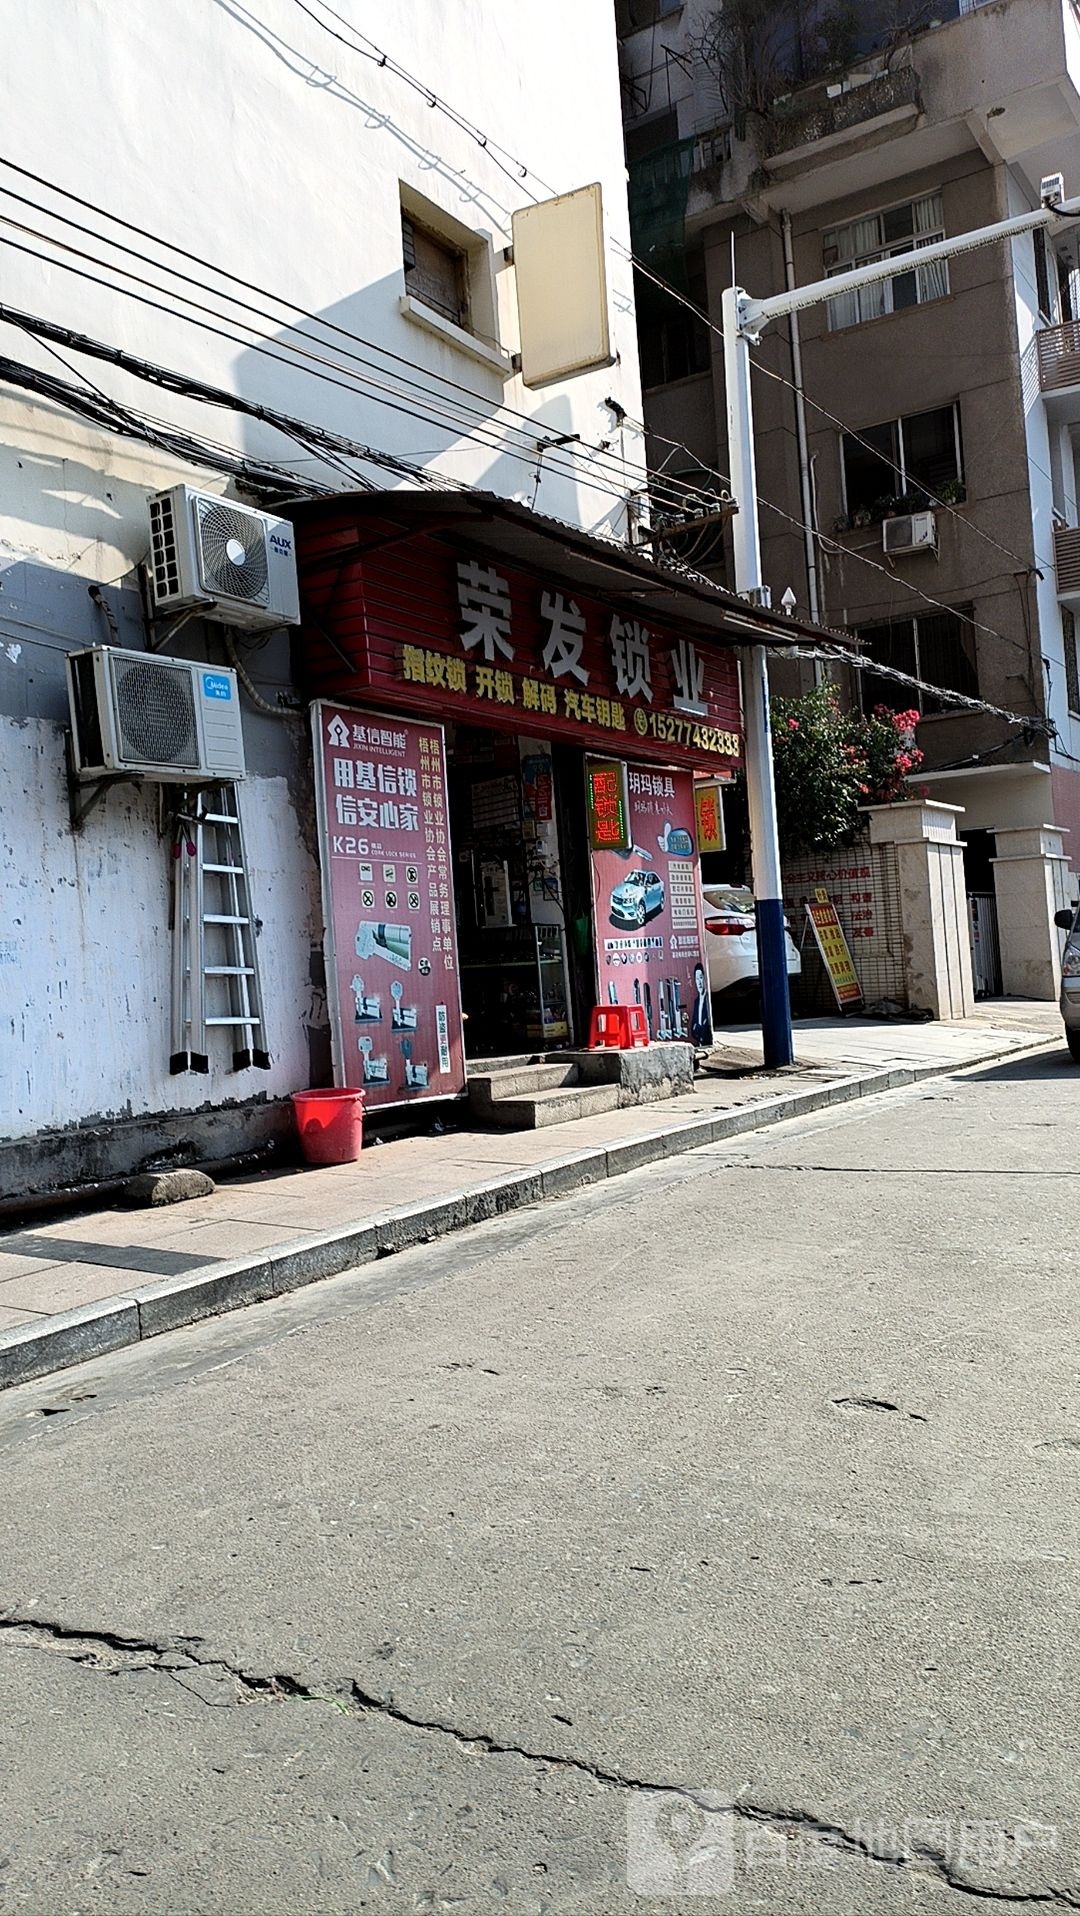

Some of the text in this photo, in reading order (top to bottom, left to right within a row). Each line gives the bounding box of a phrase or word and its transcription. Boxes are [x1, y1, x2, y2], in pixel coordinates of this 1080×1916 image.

[270, 535, 291, 549] AUX
[456, 560, 709, 717] 荣发锁业
[402, 644, 740, 758] 指纹锁 开锁 解码 汽车钥匙 15277432333
[352, 724, 407, 749] 基信智能
[369, 746, 406, 758] INTELLIGENT
[333, 757, 418, 798] 用基信锁
[629, 771, 676, 798] 玥玛锁具
[335, 793, 420, 832] 信安心家
[332, 835, 370, 855] K26
[418, 736, 442, 952] 梧州市锁业协会产品展销点
[429, 738, 456, 970] 梧州市锁业协会常务理事单位
